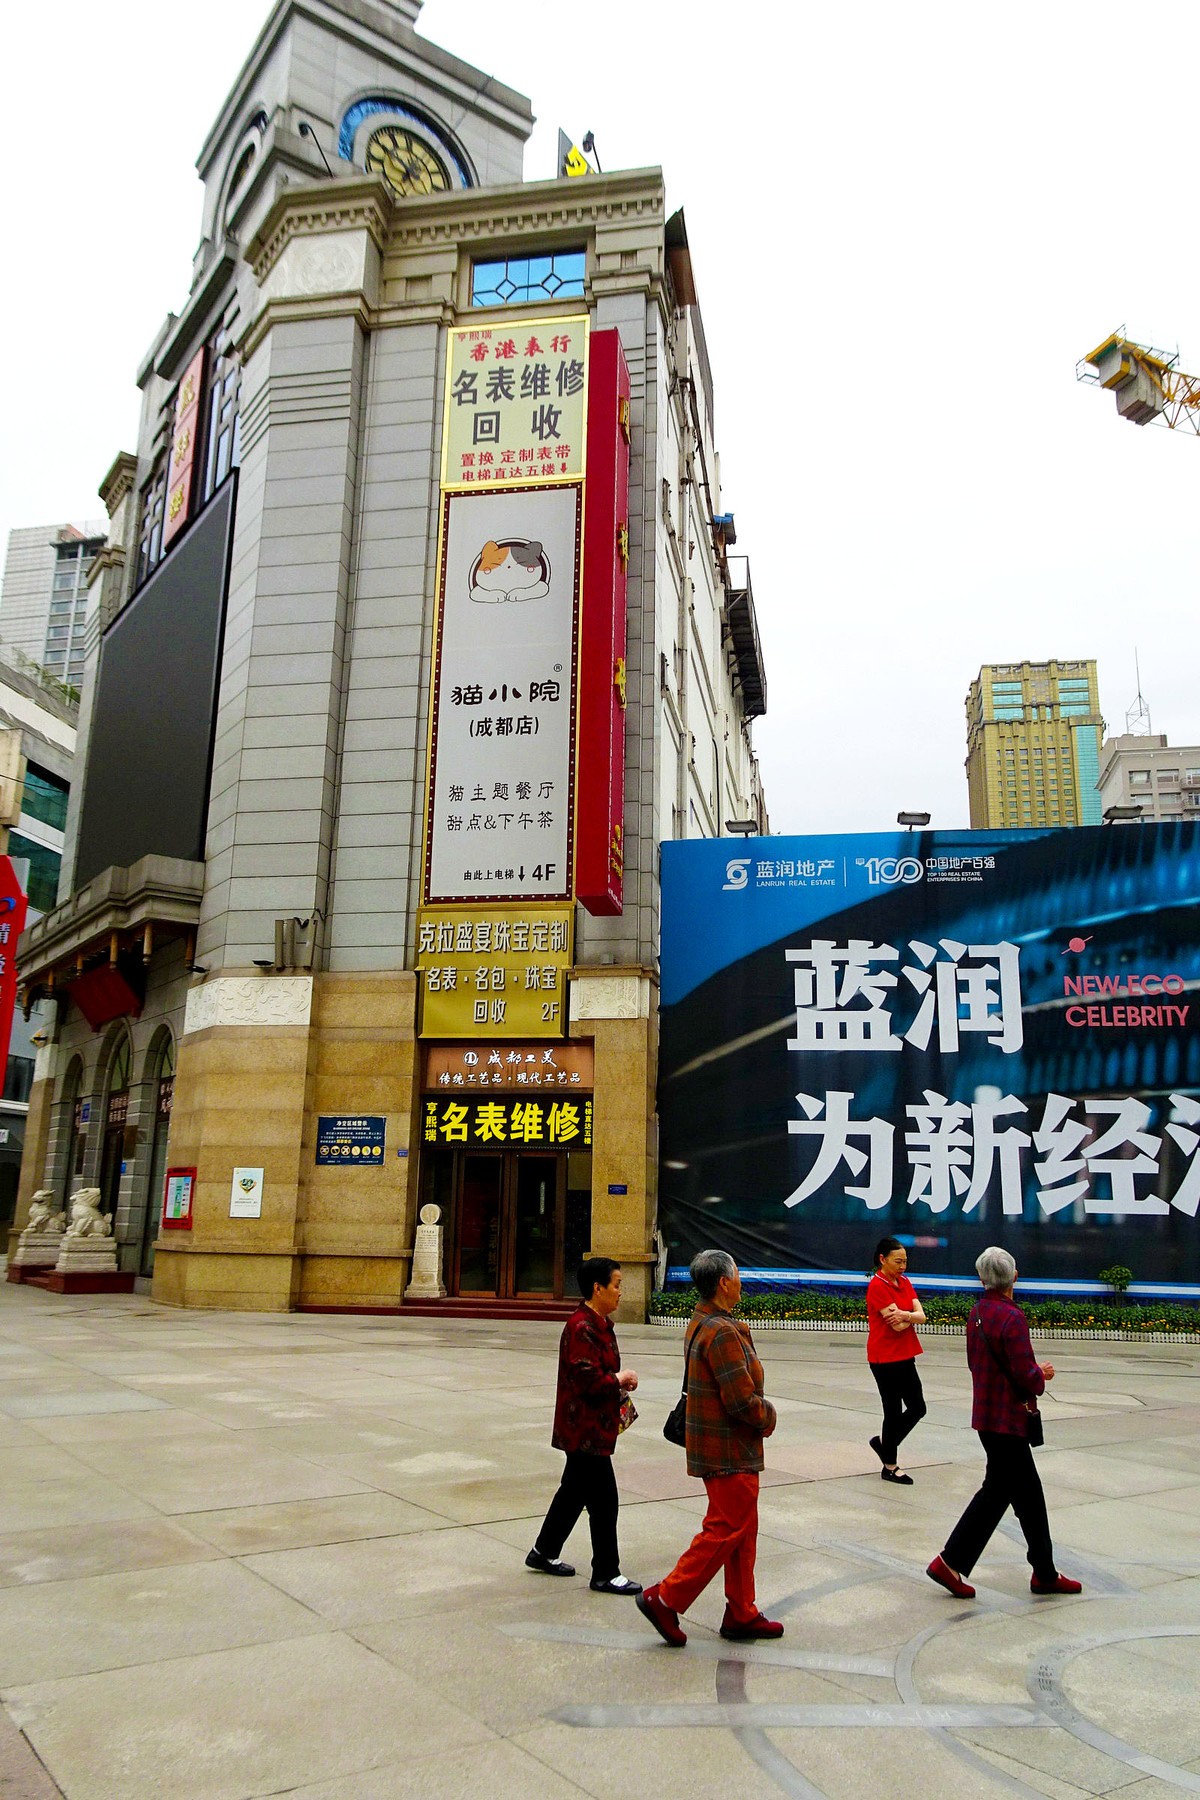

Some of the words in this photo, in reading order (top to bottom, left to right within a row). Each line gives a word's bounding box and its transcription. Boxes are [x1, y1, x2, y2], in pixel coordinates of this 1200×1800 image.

[451, 359, 584, 406] 名表维修
[472, 404, 562, 445] 回收
[500, 445, 571, 464] 定制表带
[462, 464, 555, 482] 电梯直达五楼
[450, 679, 560, 705] 猫小院
[469, 715, 540, 737] (成都店)
[448, 781, 554, 802] 猫主题餐厅
[447, 811, 554, 831] 甜点&下午茶
[463, 868, 515, 881] 由此上电梯
[531, 863, 556, 881] 4F
[756, 860, 835, 878] 蓝润地产
[925, 856, 996, 870] 中国地产百强
[756, 880, 786, 888] LANRUN
[810, 879, 836, 887] ESTATE
[418, 920, 568, 954] 克拉盛宴珠宝定制
[784, 938, 1025, 1054] 蓝润
[1064, 974, 1186, 997] NEW-ECO
[473, 999, 507, 1024] 回收
[541, 1002, 559, 1022] 2F
[1065, 1005, 1190, 1028] CELEBRITY
[487, 1049, 558, 1068] 成都工美
[424, 1102, 439, 1142] 亨熙瑞
[439, 1101, 581, 1143] 名表维修
